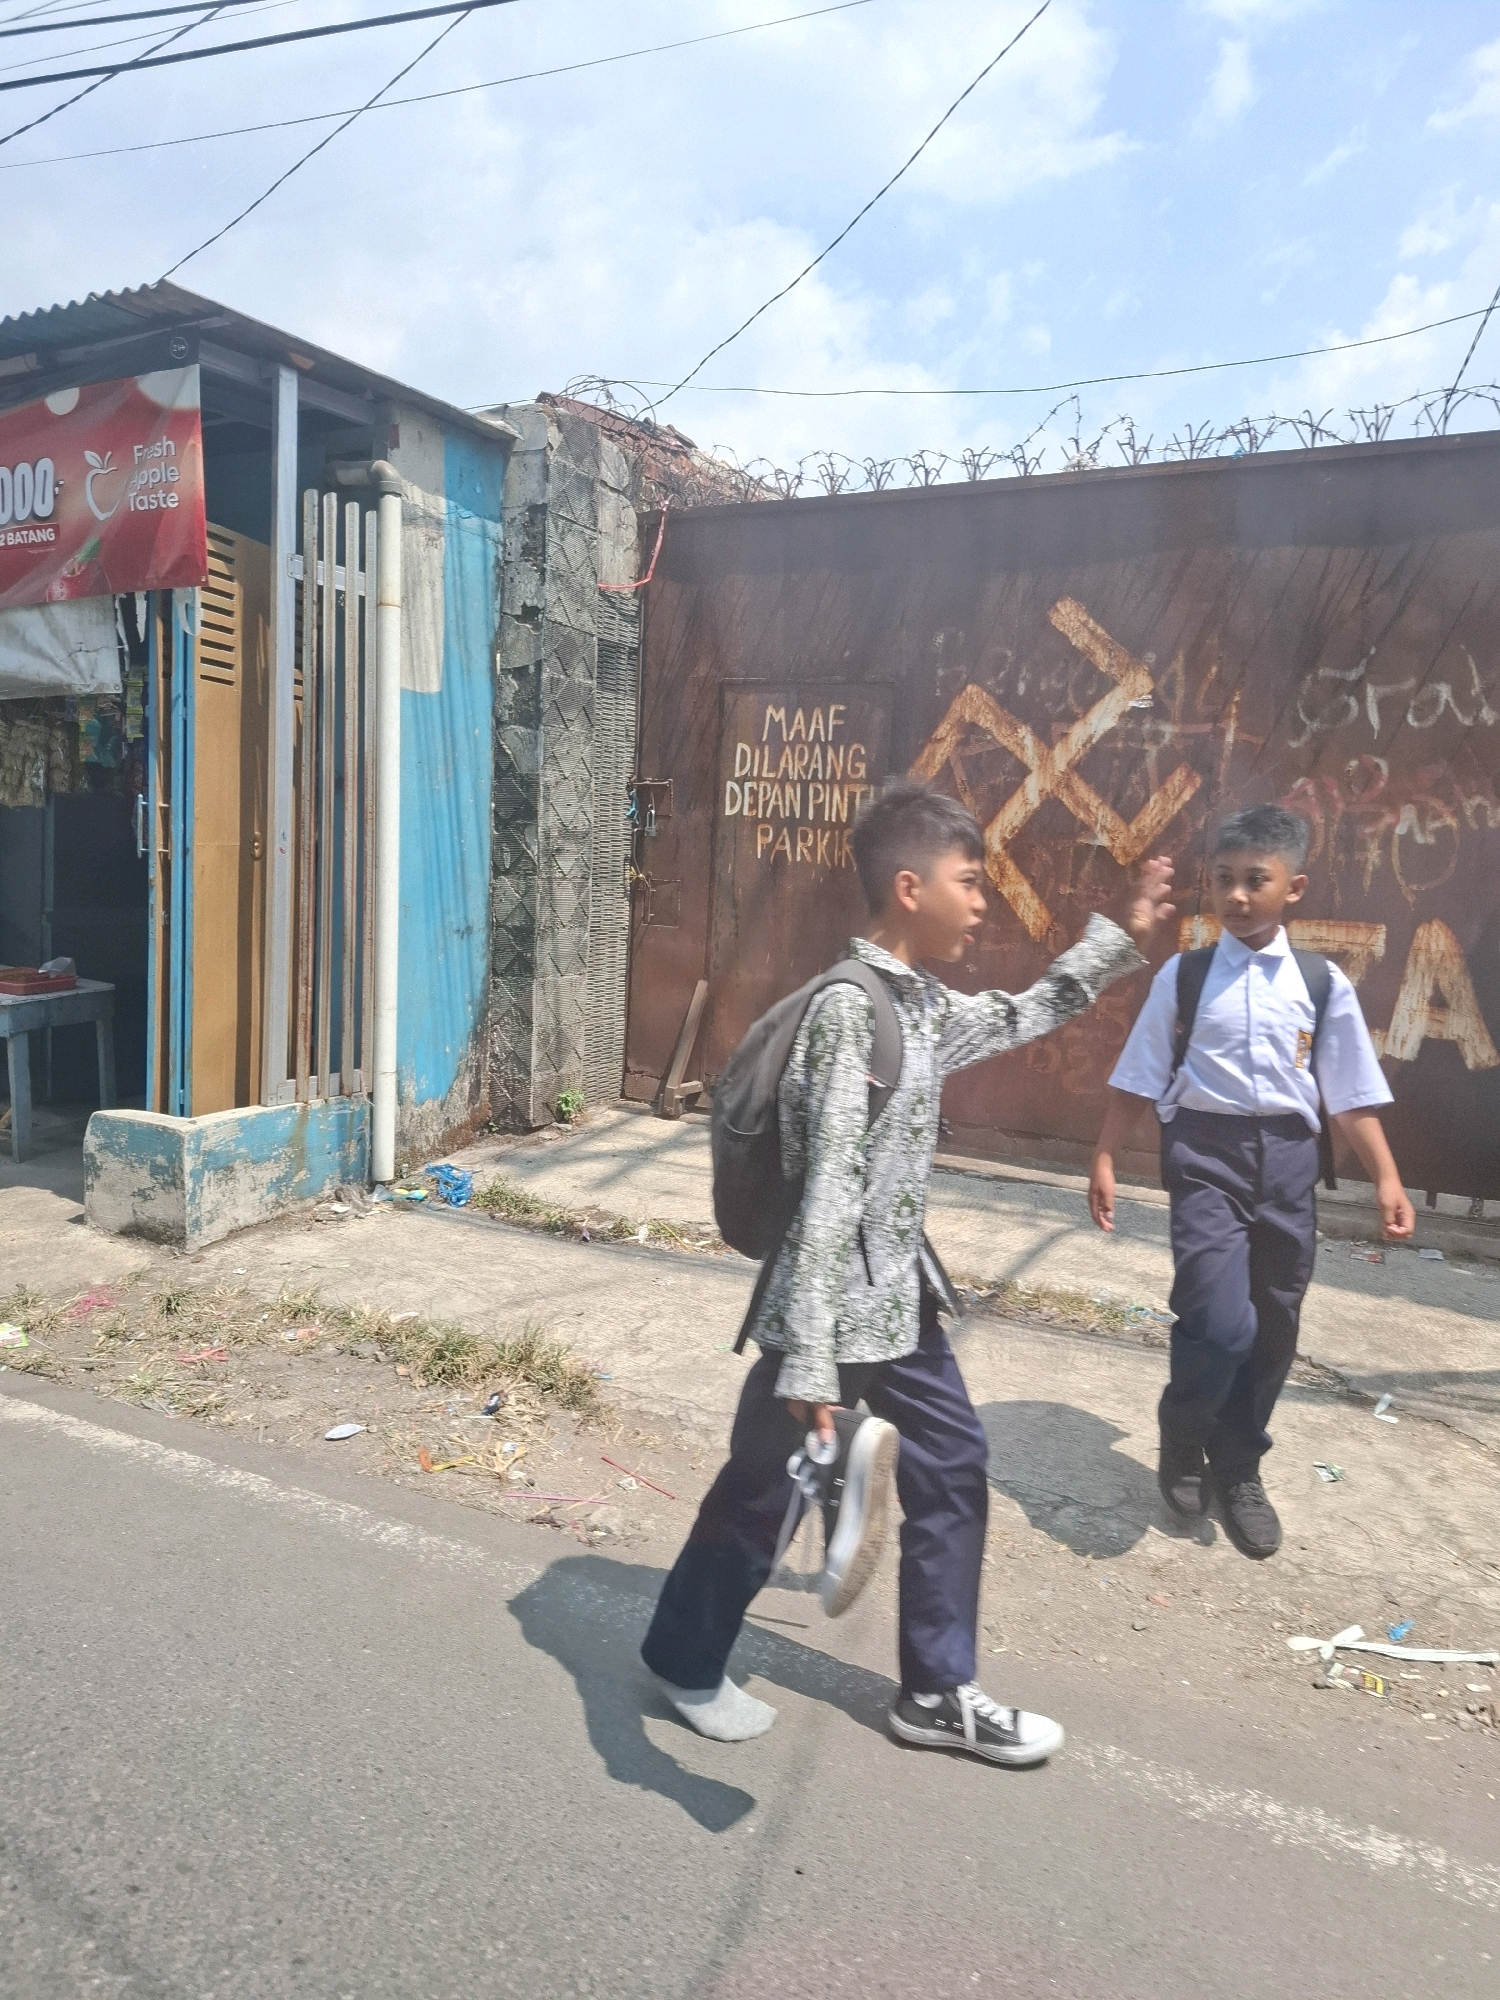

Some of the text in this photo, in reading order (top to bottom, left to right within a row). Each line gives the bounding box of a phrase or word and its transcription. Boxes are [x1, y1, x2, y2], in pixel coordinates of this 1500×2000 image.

[133, 435, 176, 465] Fresh
[128, 461, 180, 490] Apple
[129, 489, 180, 512] Taste
[6, 528, 55, 546] BATANG
[761, 704, 847, 743] MAAF
[734, 742, 867, 781] DILARANG
[724, 780, 801, 819] DEPAN
